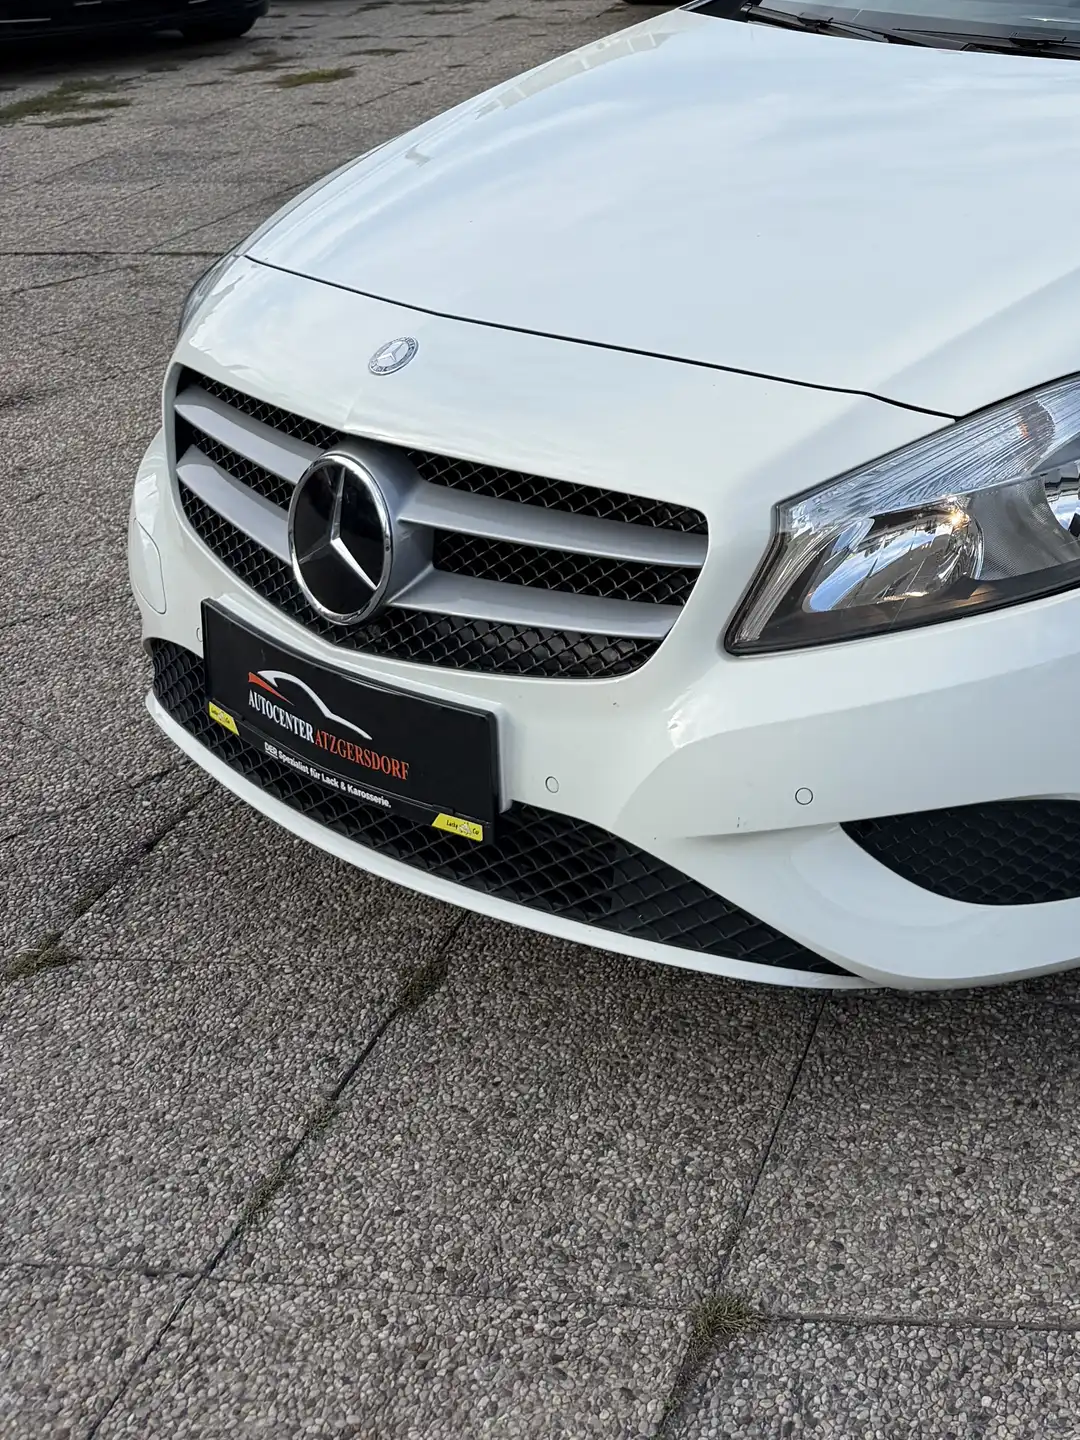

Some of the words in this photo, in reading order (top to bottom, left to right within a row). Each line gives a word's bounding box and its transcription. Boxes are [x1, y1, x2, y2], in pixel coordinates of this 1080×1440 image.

[248, 689, 314, 743] AUTOCENTER
[315, 729, 409, 780] ATZGERSDORF
[264, 742, 278, 758] DER
[278, 750, 309, 774] Spezialist
[310, 767, 321, 779] für
[321, 773, 339, 788] Lack
[340, 781, 347, 791] &
